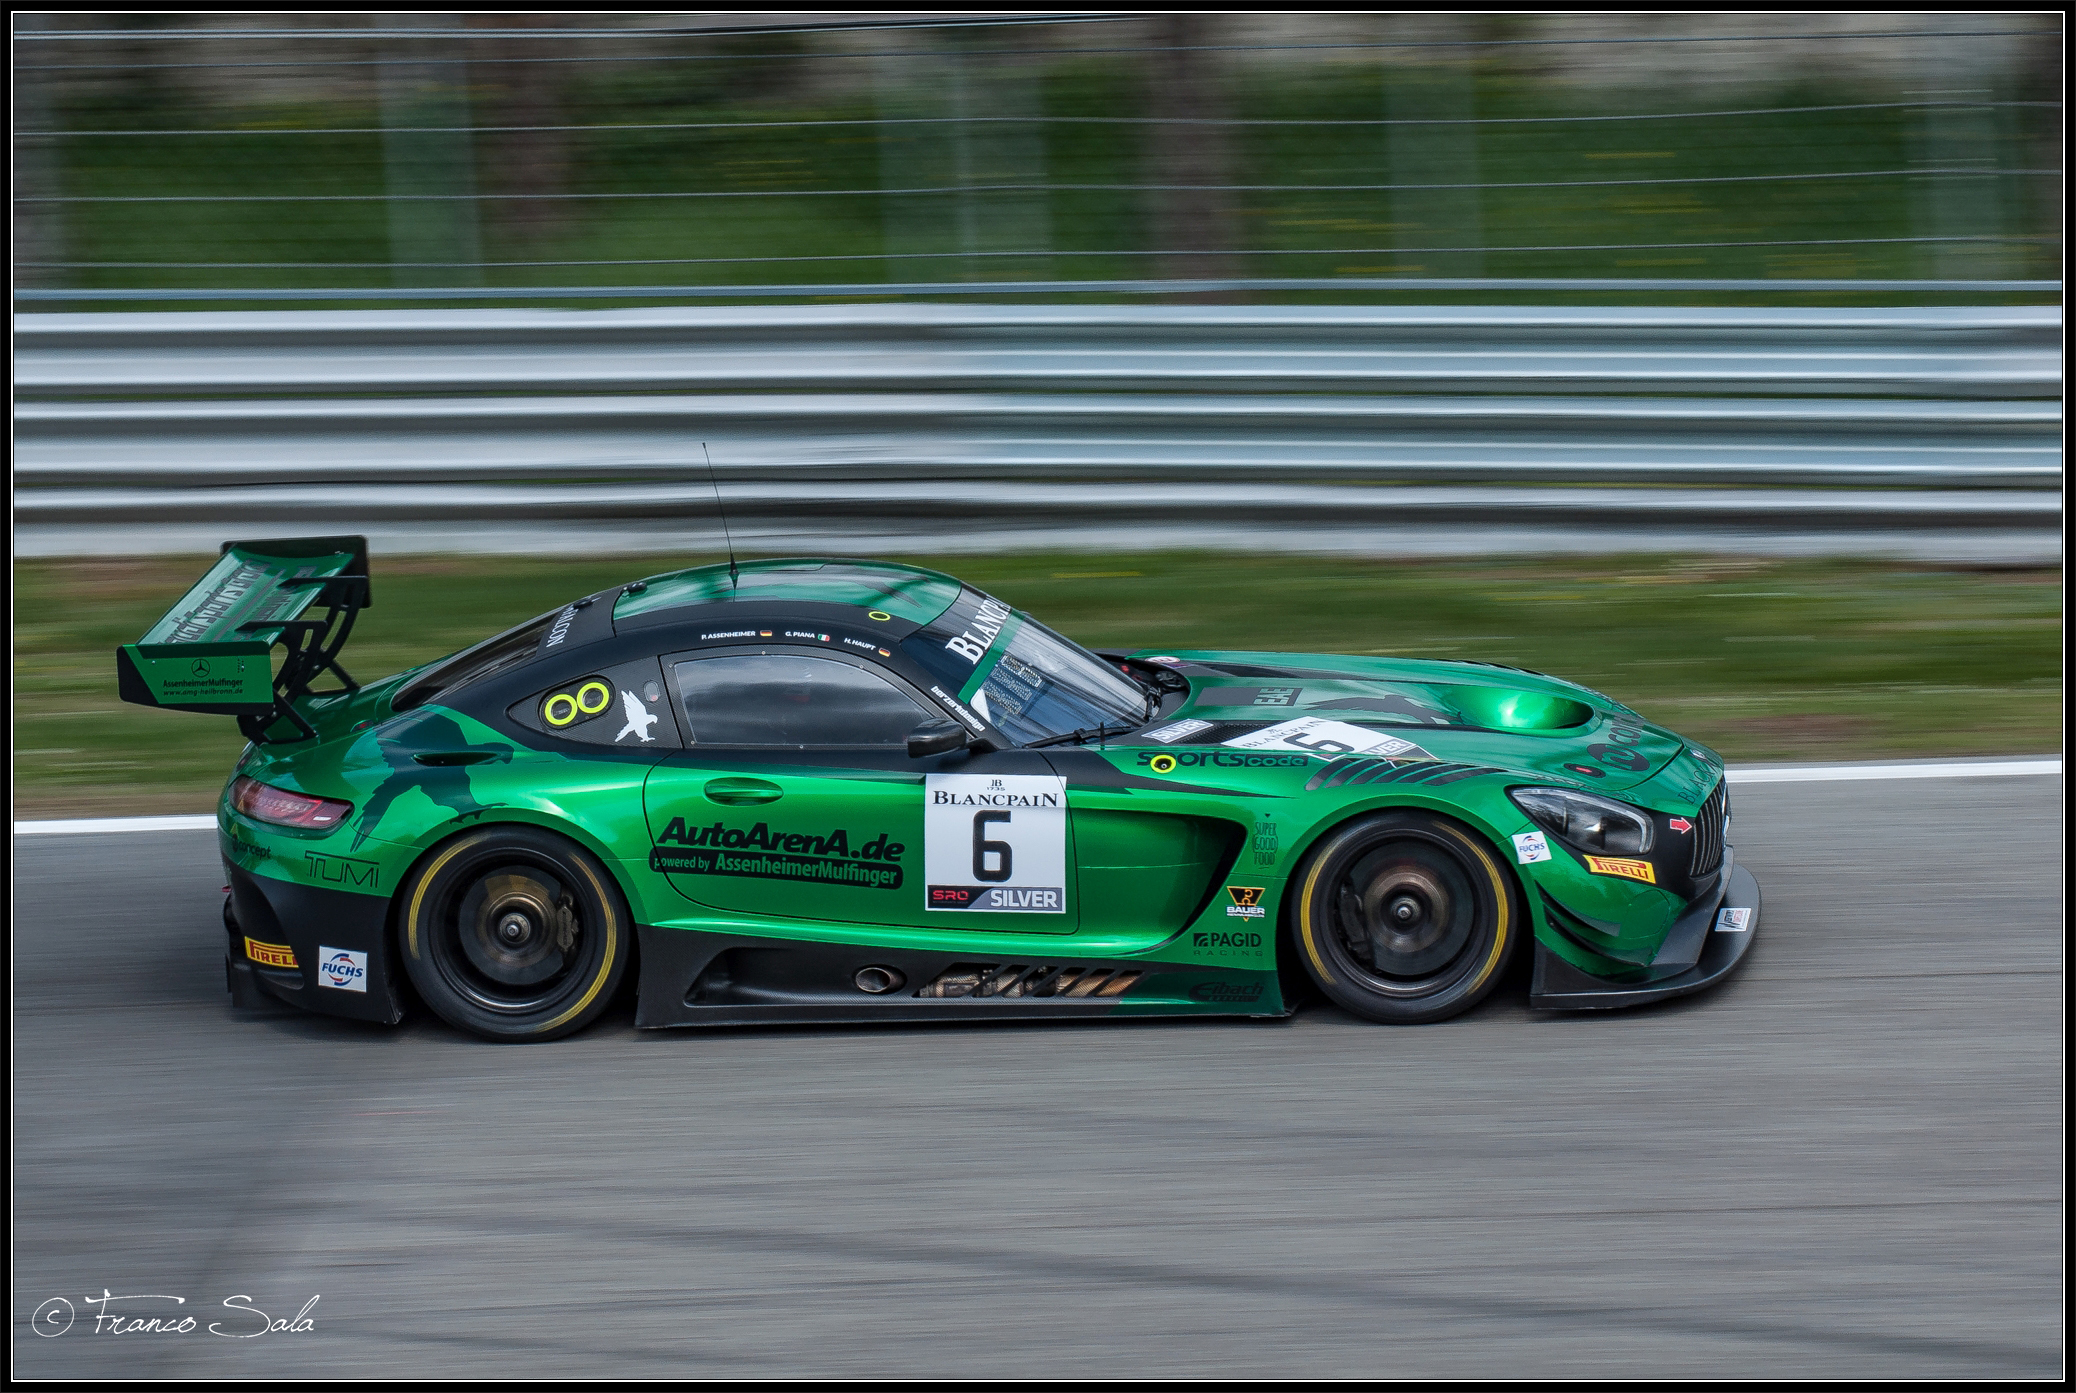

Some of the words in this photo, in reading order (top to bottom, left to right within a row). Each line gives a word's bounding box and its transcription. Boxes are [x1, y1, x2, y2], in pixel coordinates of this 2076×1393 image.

[708, 631, 756, 640] ASSENHEIMER
[851, 639, 876, 651] HAUPT
[163, 678, 244, 688] AssenheimerMulfinger
[1151, 721, 1205, 740] SILVER
[1241, 720, 1327, 747] BLANCPAIN
[1283, 732, 1355, 752] 6
[933, 791, 1058, 807] BLANCPAIN
[1255, 822, 1277, 836] SUPER
[656, 816, 905, 861] AutoArenA.de
[973, 810, 1012, 882] 6
[1519, 843, 1545, 852] FUCHS
[1254, 852, 1275, 866] FOOD
[305, 850, 380, 888] TUMI
[654, 856, 696, 869] powered
[698, 857, 710, 872] by
[715, 853, 897, 887] AssenheimerMulfinger
[1592, 857, 1649, 879] PIRELLI
[932, 890, 969, 900] SRO
[991, 890, 1058, 908] SILVER
[1226, 906, 1265, 914] BAUER
[1210, 933, 1261, 947] PAGID
[322, 963, 363, 978] FUCHS
